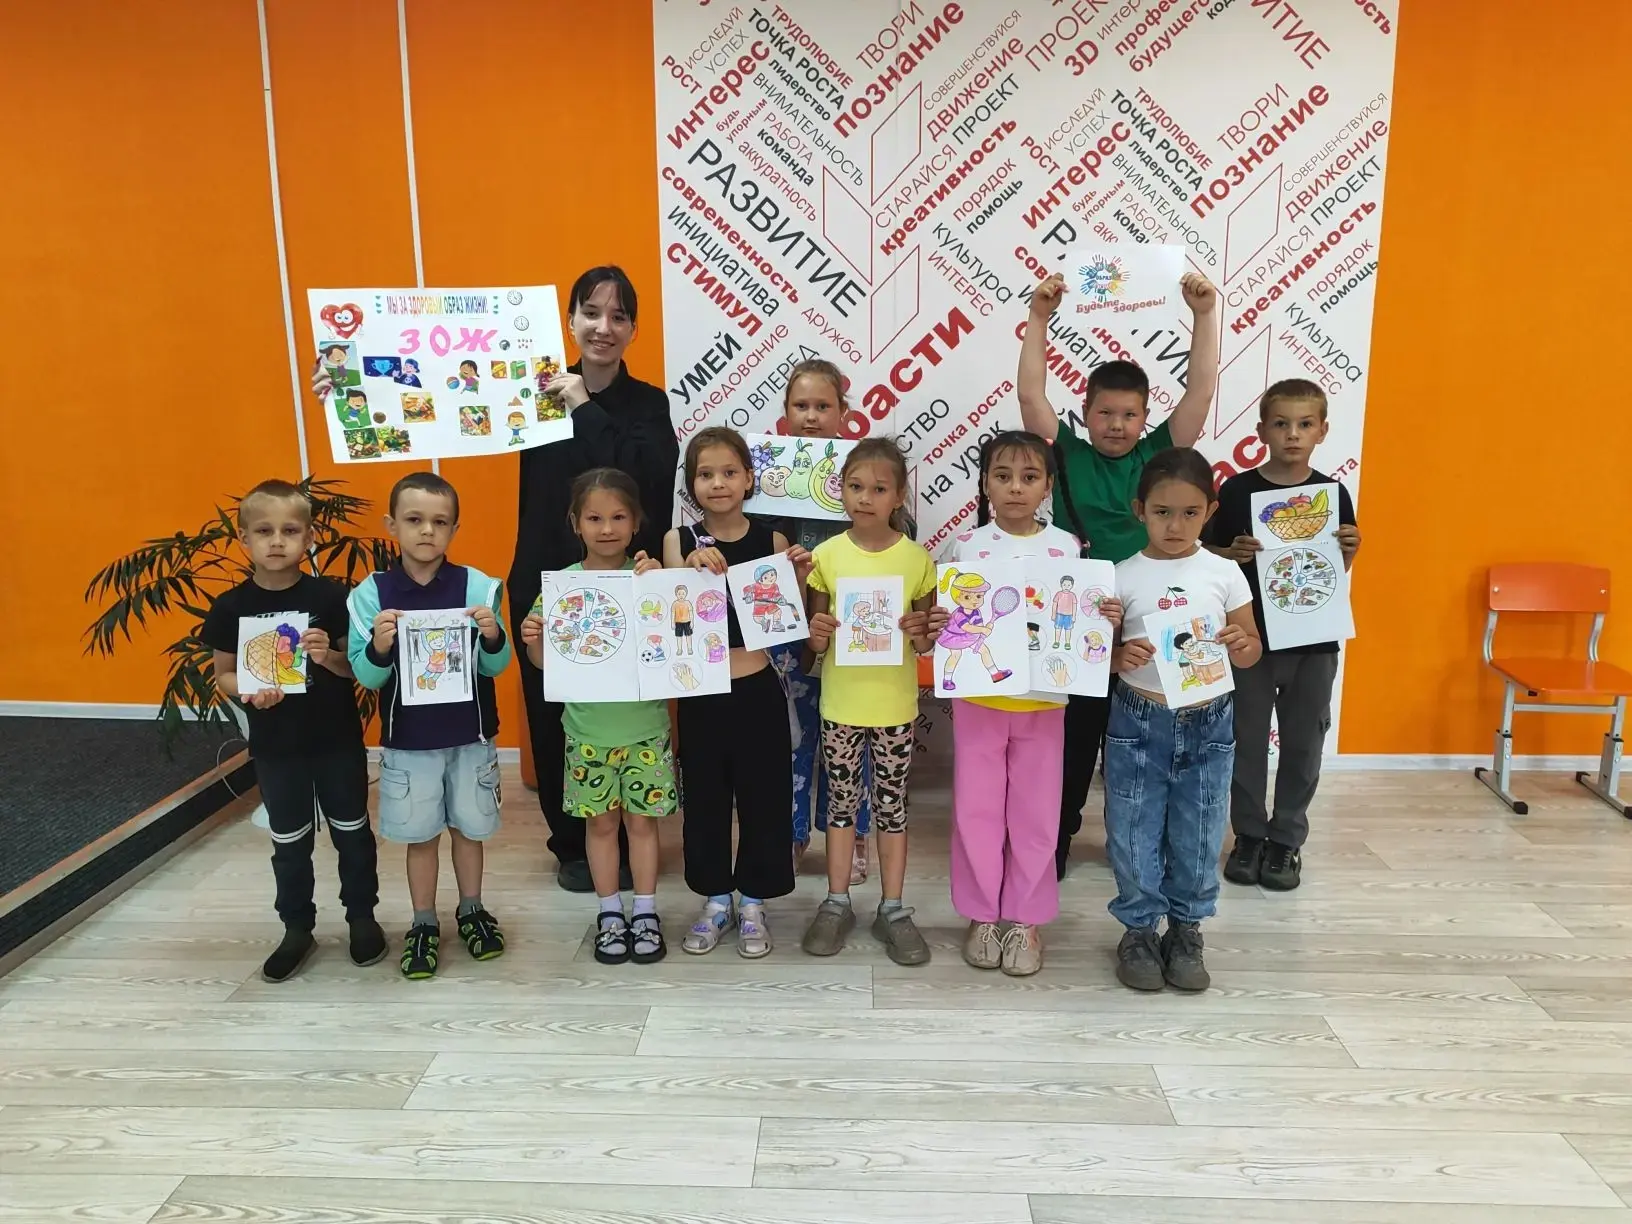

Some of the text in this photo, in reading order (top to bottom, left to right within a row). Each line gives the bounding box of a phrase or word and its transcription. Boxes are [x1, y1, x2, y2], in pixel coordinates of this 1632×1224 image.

[684, 6, 744, 70] ИССЛЕДУЙ
[704, 29, 750, 75] УСПЕХ
[748, 7, 845, 110] ТОЧКА РОСТА
[770, 4, 854, 90] ТРУДОЛЮБИЕ
[856, 0, 925, 70] ТВОРИ
[923, 9, 1022, 111] СОВЕРШЕНСТВУЙСЯ
[1064, 40, 1099, 76] 3D
[1115, 0, 1178, 56] профе
[661, 55, 702, 95] РОСТ
[667, 40, 770, 150] интерес
[768, 59, 831, 122] лидерство
[832, 2, 964, 139] познание
[926, 38, 1024, 143] движение
[715, 108, 740, 132] будь
[726, 98, 768, 144] упорным
[752, 72, 864, 187] ВНИМАТЕЛЬНОСТЬ
[763, 112, 814, 166] РАБОТА
[952, 73, 1021, 145] ПРОЕКТ
[1044, 87, 1107, 151] ИССЛЕДУЙ
[1064, 110, 1111, 156] УСПЕХ
[1110, 89, 1203, 192] ТОЧКА РОСТА
[1134, 86, 1213, 172] ТРУДОЛЮБИЕ
[1217, 82, 1289, 152] ТВОРИ
[1283, 92, 1388, 192] СОВЕРШЕНСТВУЙСЯ
[738, 141, 817, 222] аккуратность
[756, 128, 815, 187] команда
[875, 143, 958, 229] СТАРАЙСЯ
[1020, 136, 1061, 175] РОСТ
[1021, 121, 1131, 230] интерес
[1128, 140, 1188, 203] лидерство
[1189, 84, 1330, 219] познание
[1284, 120, 1388, 223] движение
[880, 120, 1017, 256] креативность
[952, 158, 1017, 222] порядок
[966, 179, 1023, 235] помощь
[1072, 188, 1097, 213] будь
[1082, 179, 1126, 225] упорным
[1112, 153, 1217, 267] ВНИМАТЕЛЬНОСТЬ
[1120, 192, 1169, 244] РАБОТА
[1310, 154, 1382, 226] ПРОЕКТ
[661, 166, 799, 304] современность
[667, 205, 780, 317] инициатива
[687, 138, 867, 318] РАЗВИТИЕ
[1112, 209, 1151, 244] кома
[927, 250, 994, 317] ИНТЕРЕС
[932, 222, 1014, 305] культура
[1227, 225, 1315, 309] СТАРАЙСЯ
[1230, 201, 1377, 335] креативность
[1306, 239, 1374, 302] порядок
[1319, 260, 1379, 314] помощь
[399, 295, 408, 315] ЗА
[444, 296, 464, 314] ОБРАЗ
[801, 307, 863, 364] дружба
[1076, 299, 1119, 314] Будьте
[1113, 296, 1166, 313] здоровы!
[670, 331, 742, 406] УМЕЙ
[1278, 330, 1343, 396] ИНТЕРЕС
[1284, 302, 1363, 383] культура
[675, 323, 790, 444] исследование
[923, 422, 968, 466] точка
[967, 380, 1015, 427] роста
[920, 473, 954, 505] на
